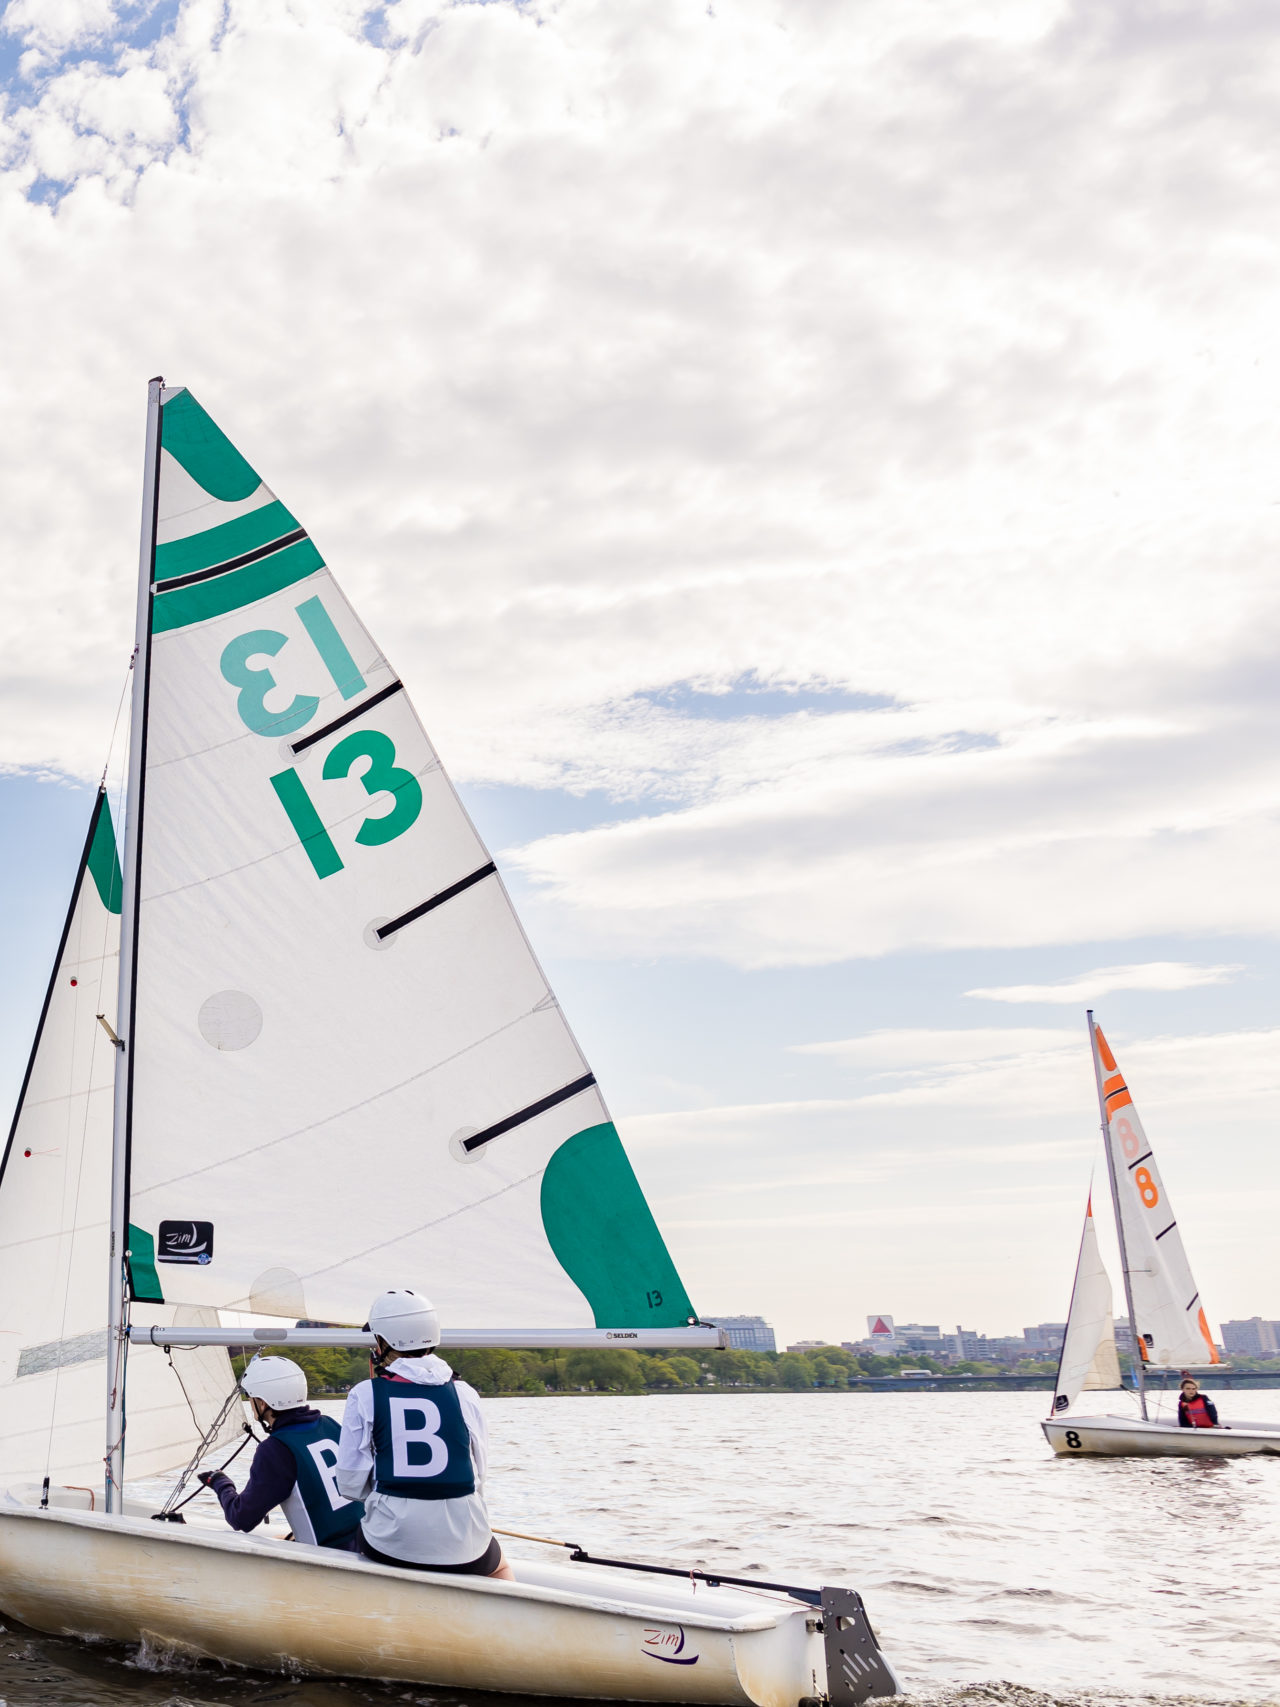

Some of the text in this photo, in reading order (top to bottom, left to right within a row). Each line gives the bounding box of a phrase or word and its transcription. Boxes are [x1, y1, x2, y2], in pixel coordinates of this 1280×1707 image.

[269, 729, 423, 880] 13
[1135, 1166, 1158, 1208] 8
[646, 1290, 663, 1309] 13
[389, 1397, 449, 1478] B
[1065, 1430, 1082, 1449] 8
